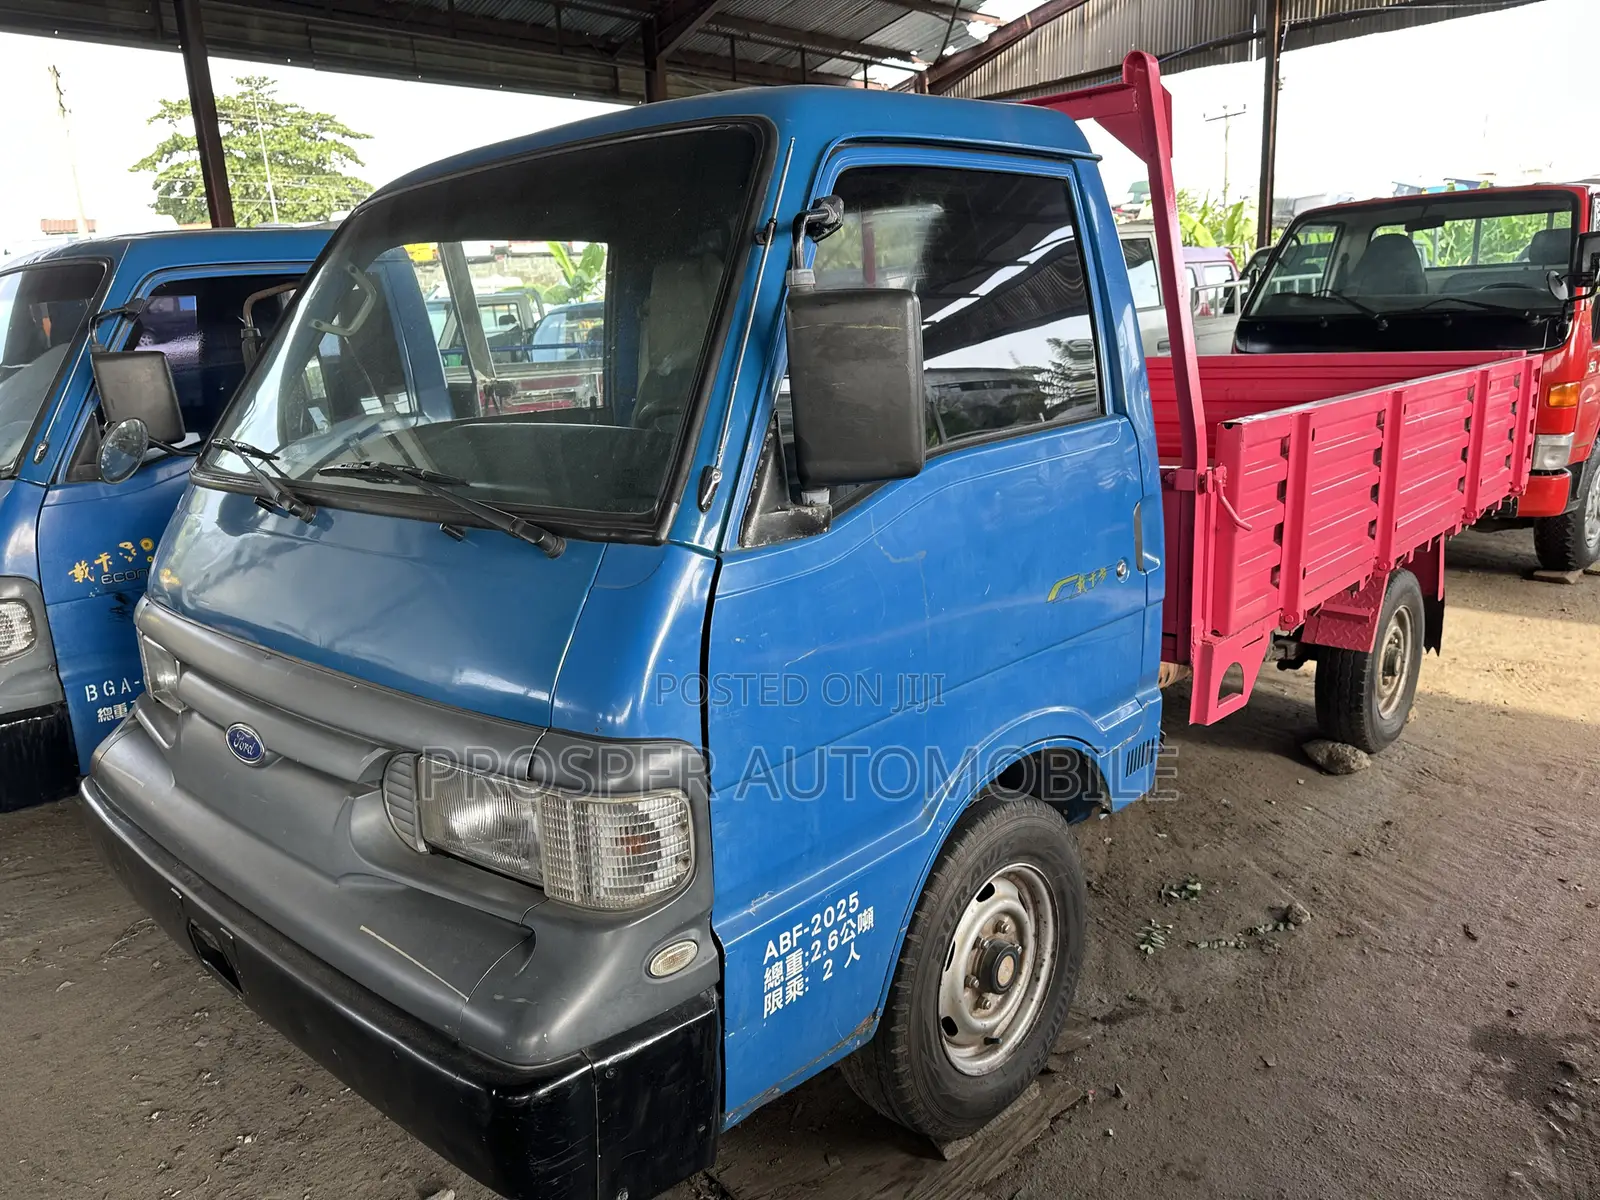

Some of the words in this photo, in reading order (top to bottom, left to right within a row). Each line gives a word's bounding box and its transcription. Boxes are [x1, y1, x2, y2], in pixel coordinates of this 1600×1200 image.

[233, 730, 256, 756] Ford
[763, 890, 859, 965] ABF-2025
[822, 958, 834, 982] 2
[843, 941, 861, 969] 人
